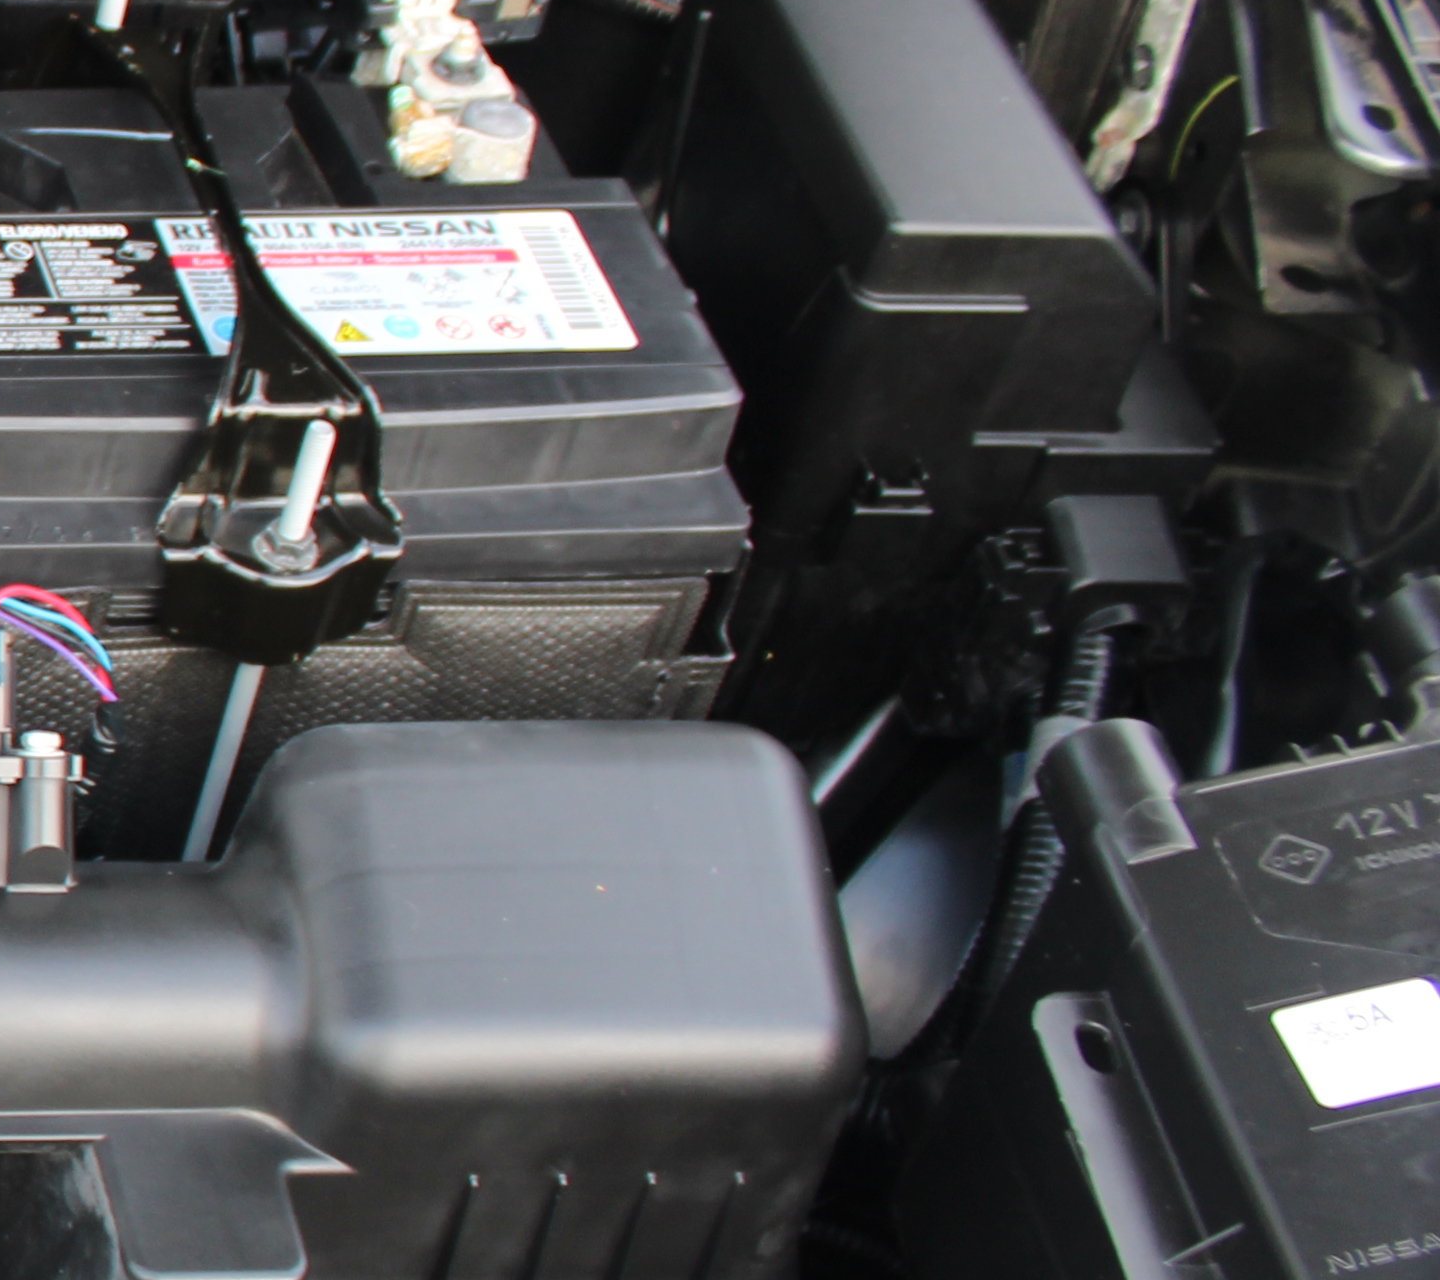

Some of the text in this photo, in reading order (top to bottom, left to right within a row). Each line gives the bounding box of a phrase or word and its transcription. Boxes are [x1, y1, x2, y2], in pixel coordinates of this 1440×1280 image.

[169, 219, 498, 241] REAULT NISSAN
[1334, 799, 1419, 840] 12V
